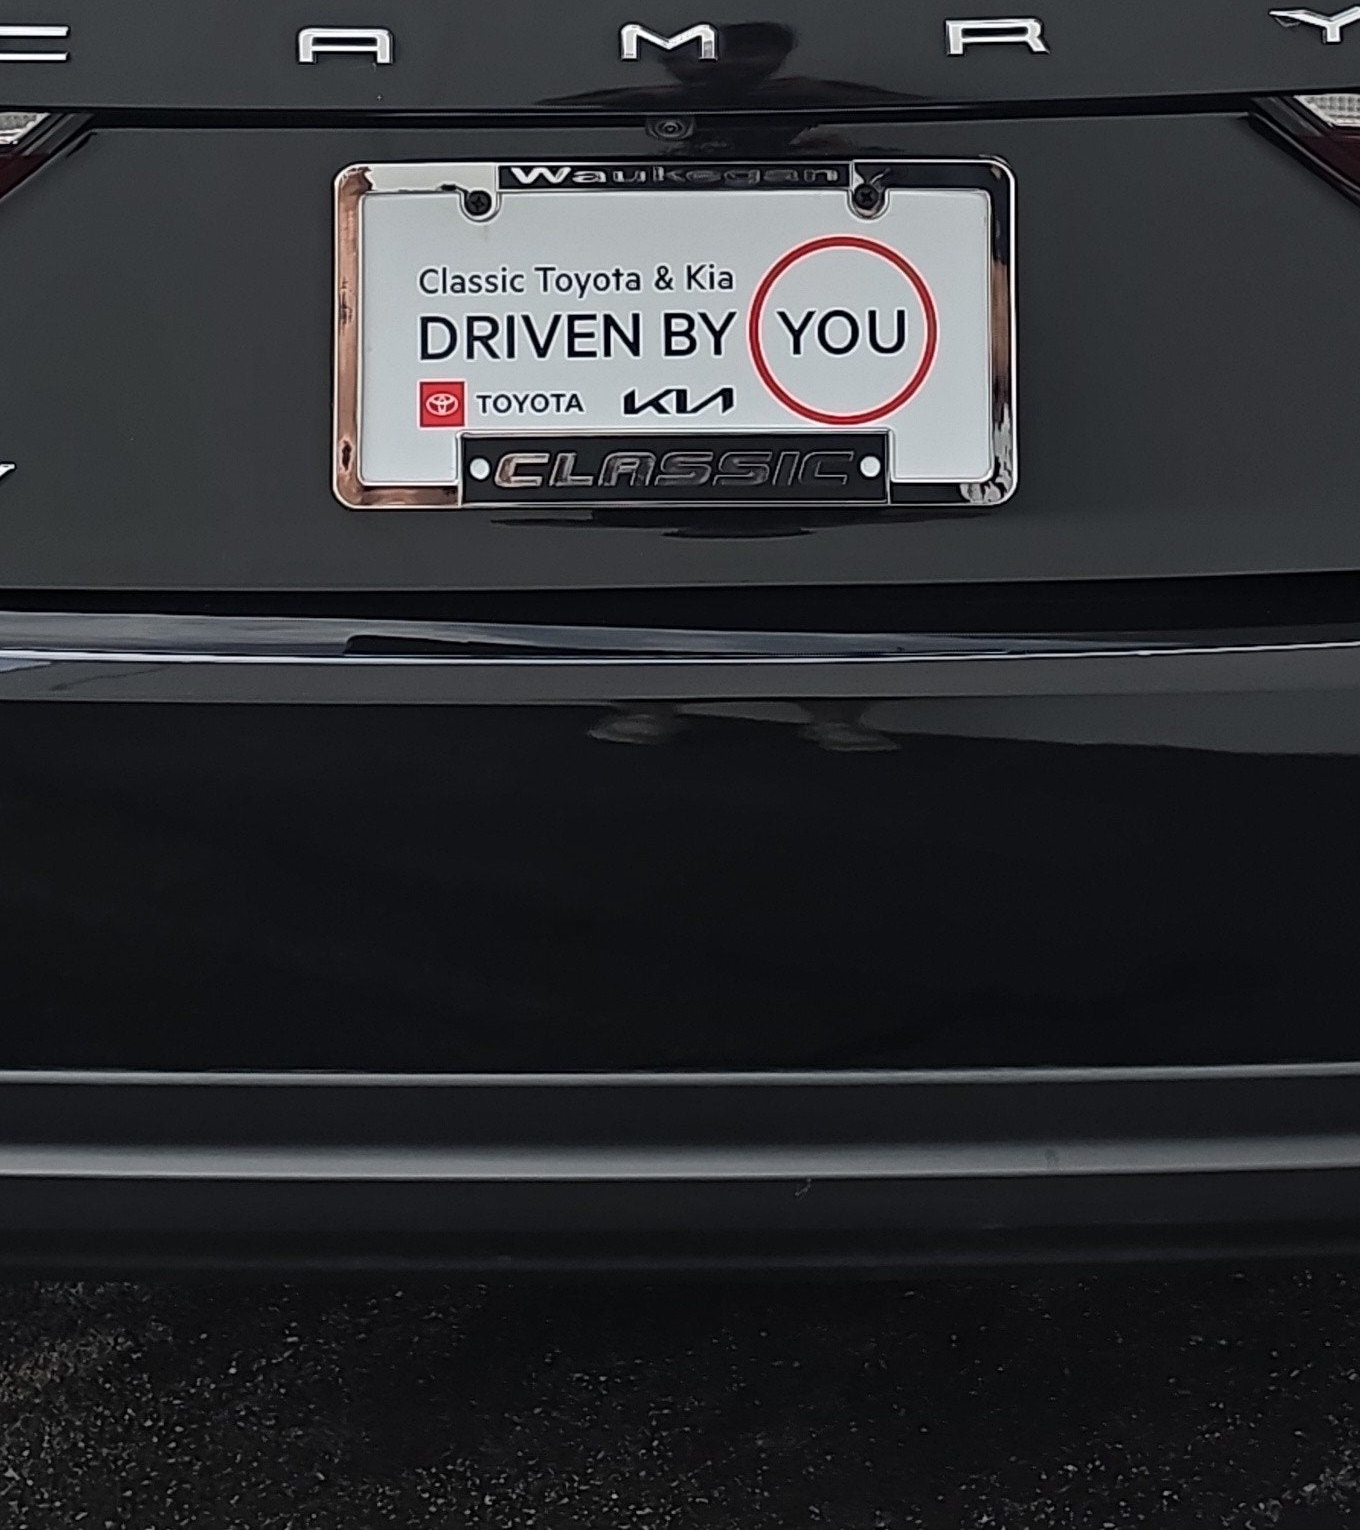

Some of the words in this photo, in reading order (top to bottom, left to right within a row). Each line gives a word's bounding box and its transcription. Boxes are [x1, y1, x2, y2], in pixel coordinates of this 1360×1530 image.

[510, 166, 839, 186] Waukegan
[419, 266, 525, 294] Classic
[535, 266, 641, 299] Toyota
[654, 265, 675, 291] &
[686, 263, 734, 291] Kia
[420, 312, 641, 361] DRIVEN
[663, 311, 738, 357] BY
[776, 308, 907, 356] YOU
[476, 393, 584, 414] TOYOTA
[493, 450, 855, 488] CLASSIC
